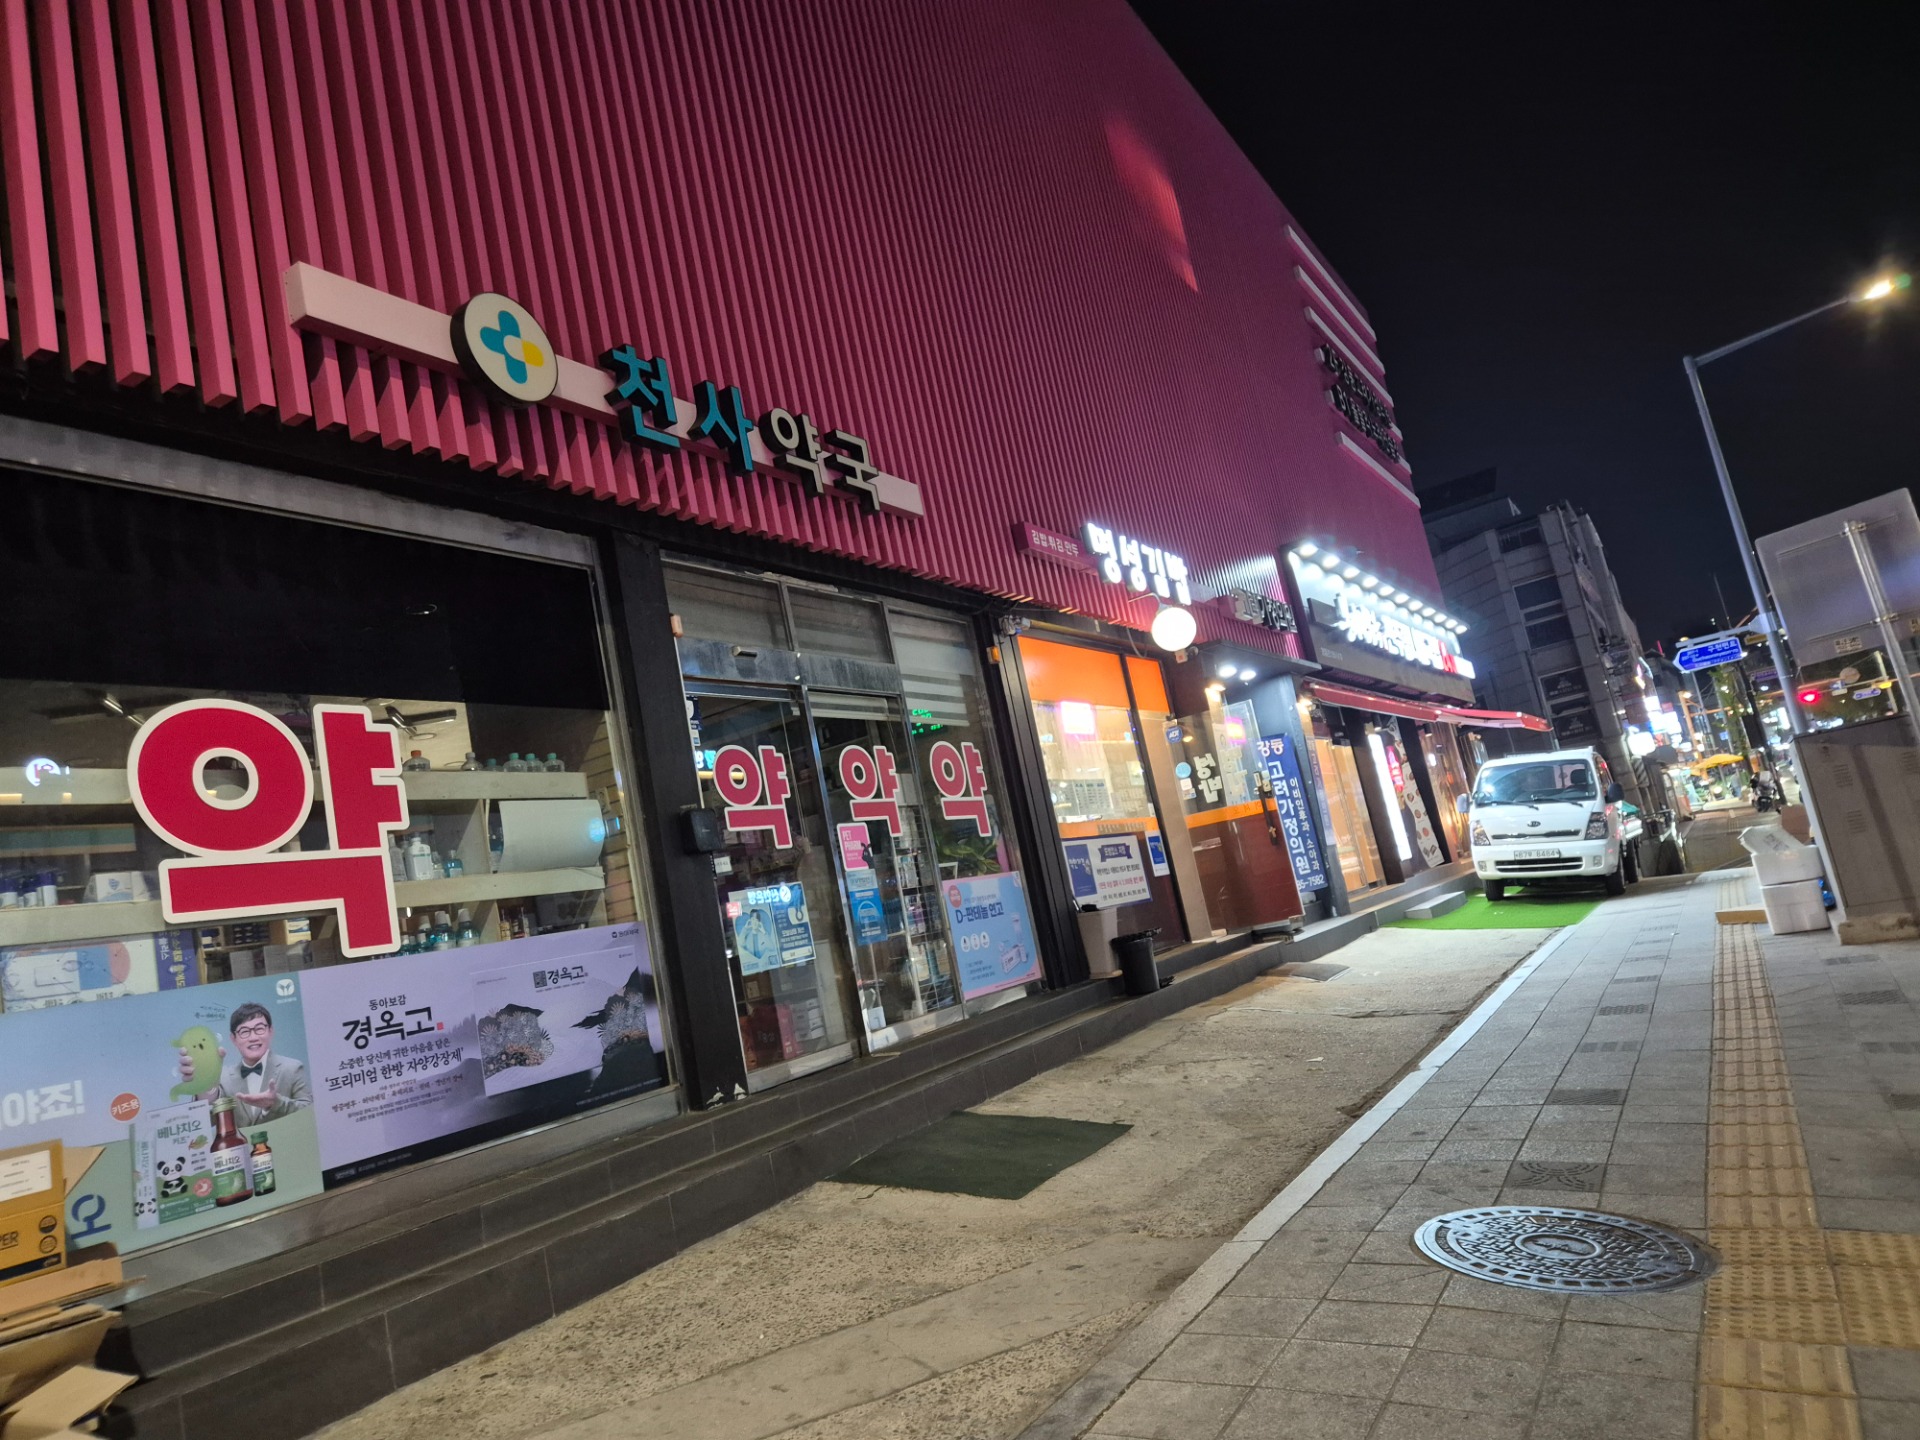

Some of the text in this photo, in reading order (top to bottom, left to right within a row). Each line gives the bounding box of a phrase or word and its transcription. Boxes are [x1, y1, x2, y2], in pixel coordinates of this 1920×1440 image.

[602, 344, 881, 513] 천사약국
[1087, 522, 1192, 606] 명성김밥
[1257, 738, 1284, 757] 강동
[713, 745, 793, 849] 약
[839, 744, 903, 838] 약
[929, 741, 993, 837] 약
[128, 698, 409, 958] 약
[1268, 760, 1311, 875] 고려가정의원
[989, 901, 1004, 917] 연고
[547, 965, 584, 985] 경옥고
[369, 995, 406, 1010] 동아보감
[342, 1006, 435, 1050] 경옥고
[338, 1058, 365, 1071] 소중한
[392, 1047, 409, 1060] 귀한
[410, 1042, 434, 1055] 마음을
[435, 1037, 451, 1050] 담은
[380, 1062, 404, 1080] 한방
[111, 1098, 139, 1115] 키즈용
